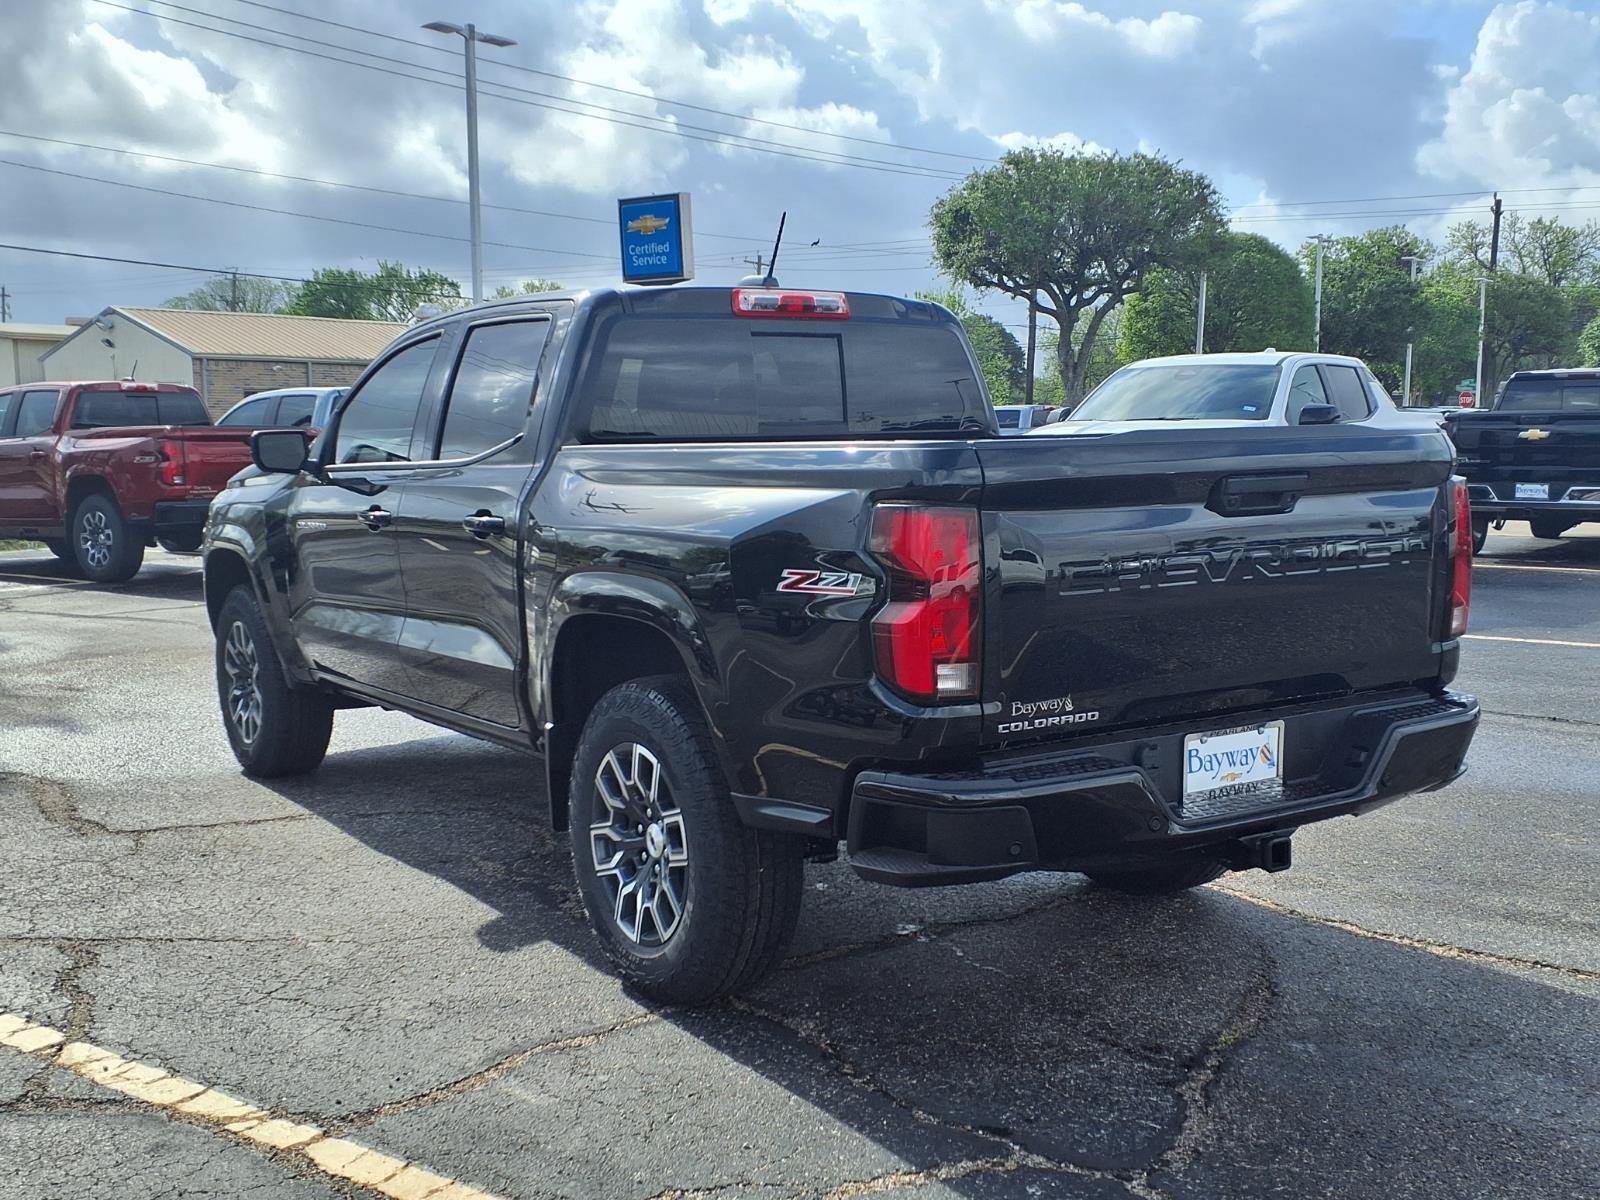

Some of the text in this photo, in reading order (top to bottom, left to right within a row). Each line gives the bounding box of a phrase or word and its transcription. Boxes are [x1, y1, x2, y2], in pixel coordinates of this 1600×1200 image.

[628, 241, 670, 255] Certified
[632, 254, 667, 266] Service
[1460, 396, 1473, 404] STOP
[776, 569, 862, 596] Z71
[1011, 697, 1065, 718] Bayway
[998, 711, 1099, 734] COLORADO
[1187, 746, 1260, 780] Bayway
